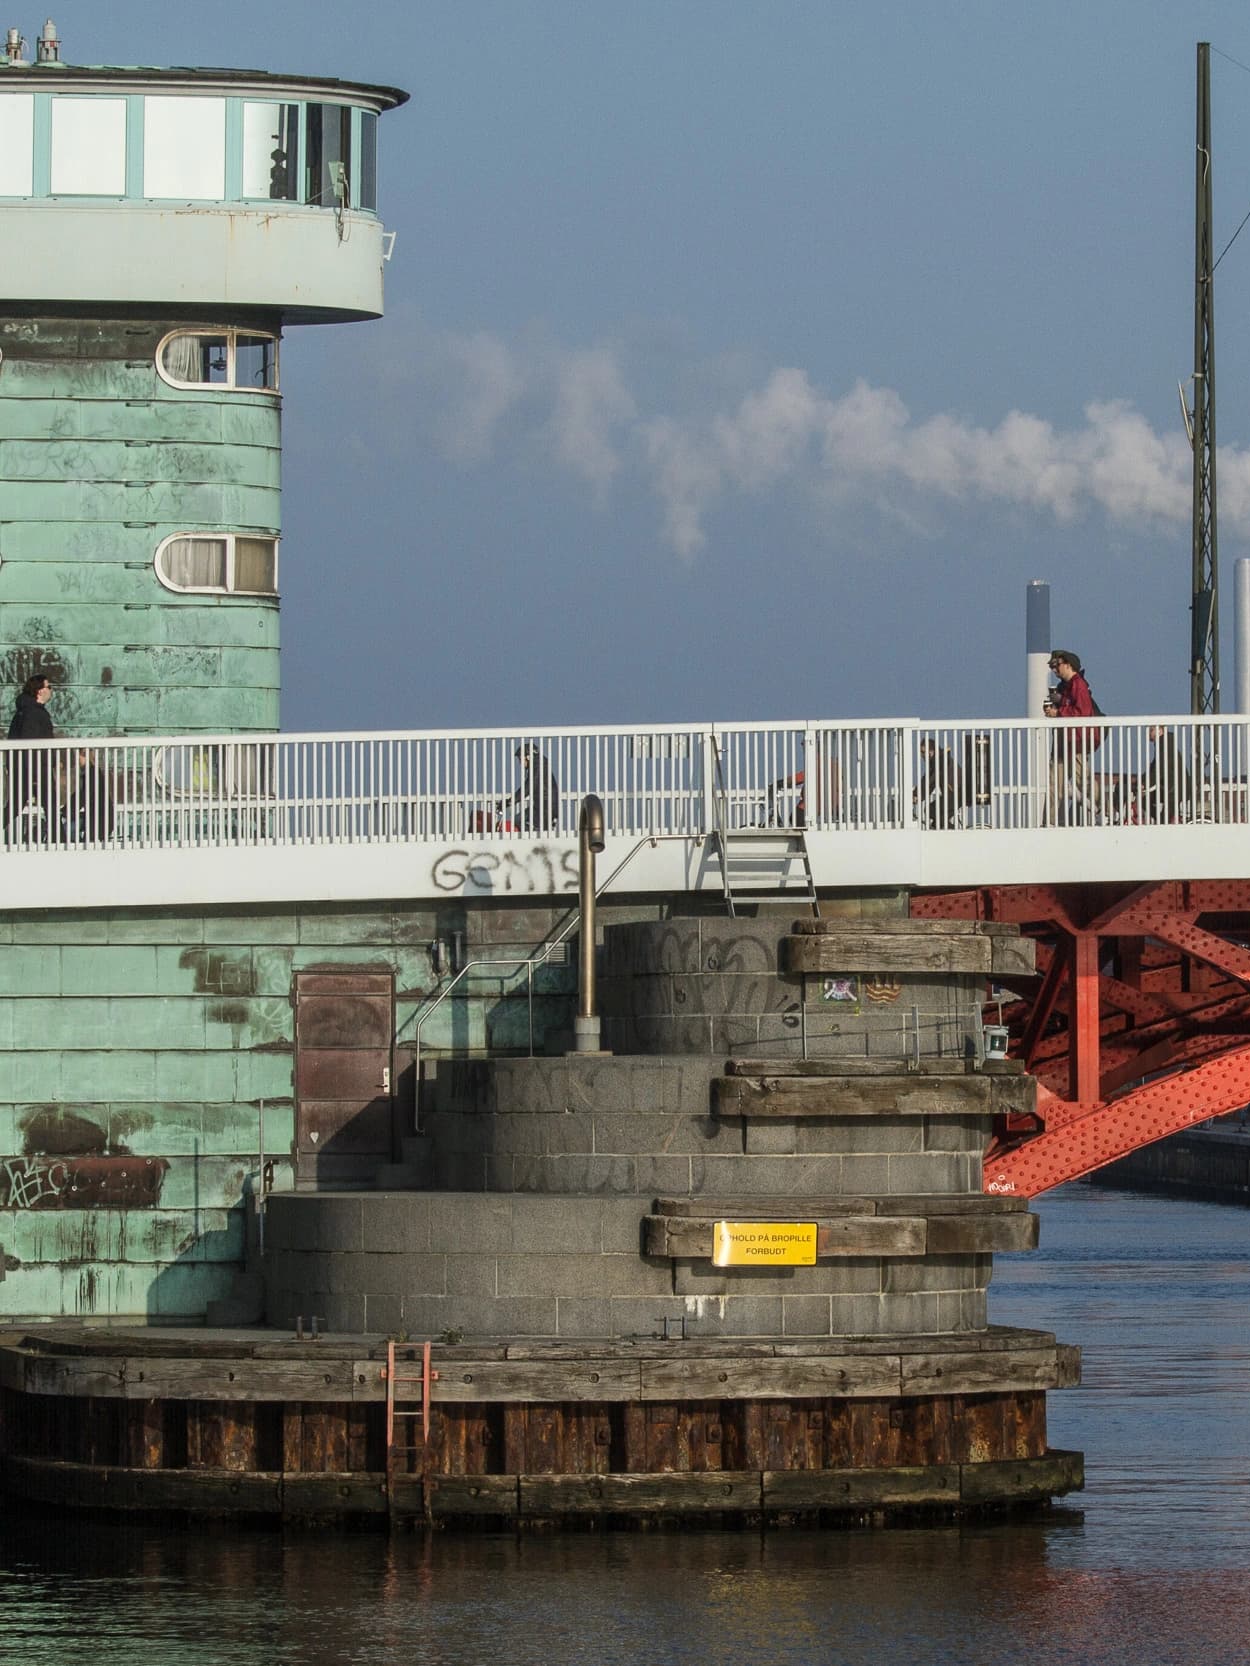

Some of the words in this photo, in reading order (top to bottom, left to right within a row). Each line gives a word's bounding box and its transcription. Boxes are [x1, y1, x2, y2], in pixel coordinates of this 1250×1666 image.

[719, 1234, 756, 1242] OHOLD
[758, 1232, 770, 1242] PÅ
[771, 1234, 812, 1242] BROPILLE
[746, 1247, 786, 1255] FORBUDT
